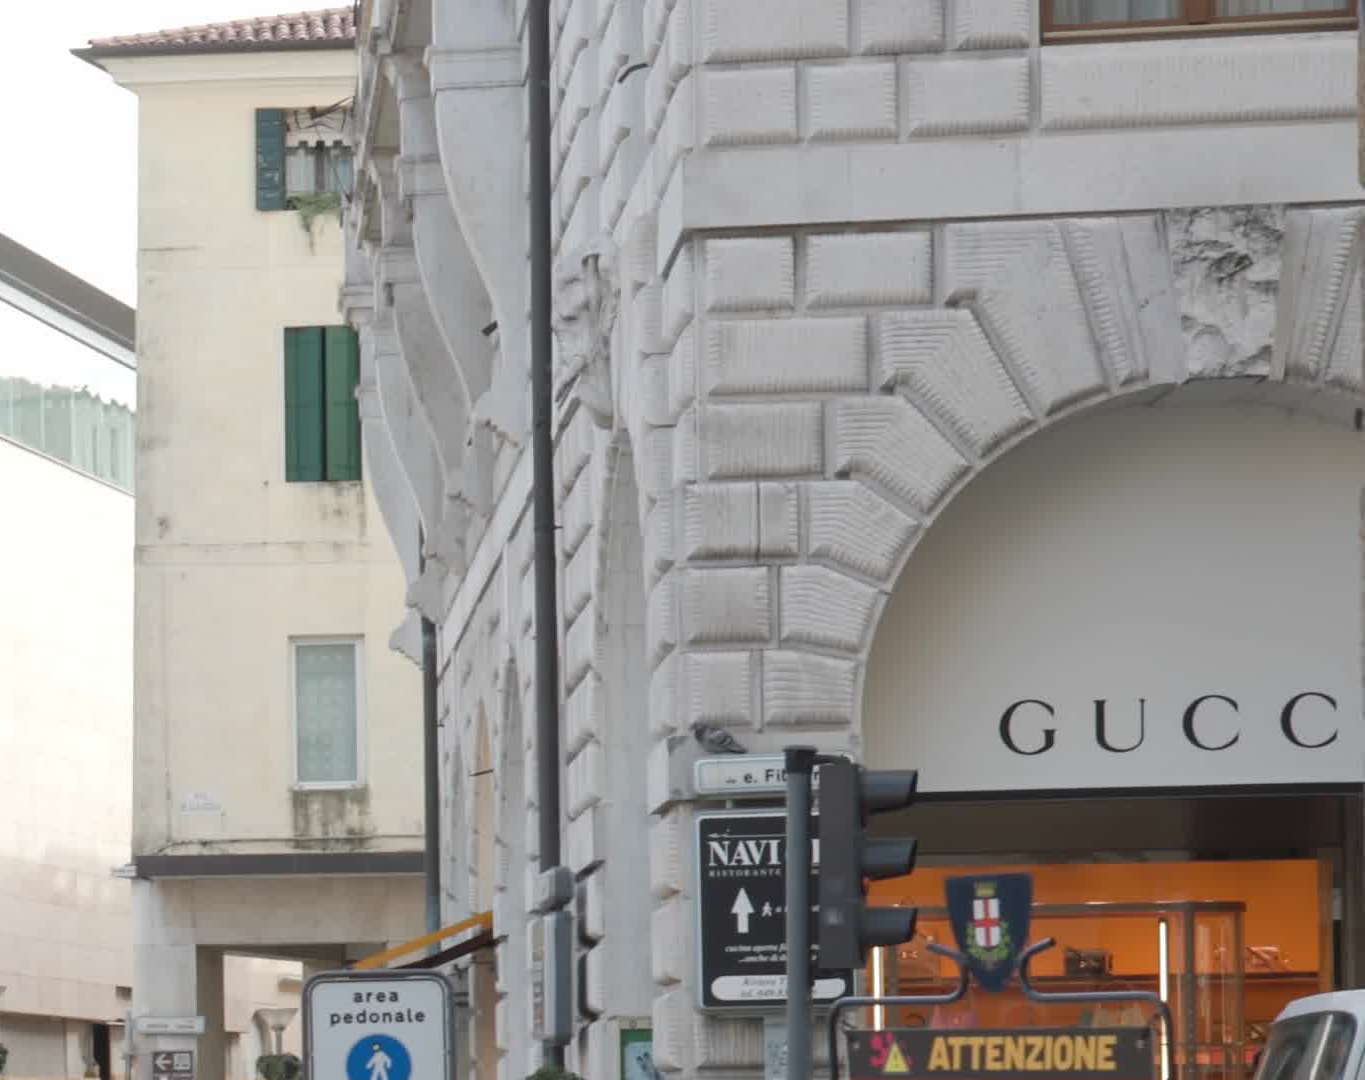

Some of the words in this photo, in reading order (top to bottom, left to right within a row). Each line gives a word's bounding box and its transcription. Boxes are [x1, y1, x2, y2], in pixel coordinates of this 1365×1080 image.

[353, 991, 399, 1003] area
[329, 1008, 426, 1027] pedonale
[927, 1035, 1117, 1071] ATTENZIONE
